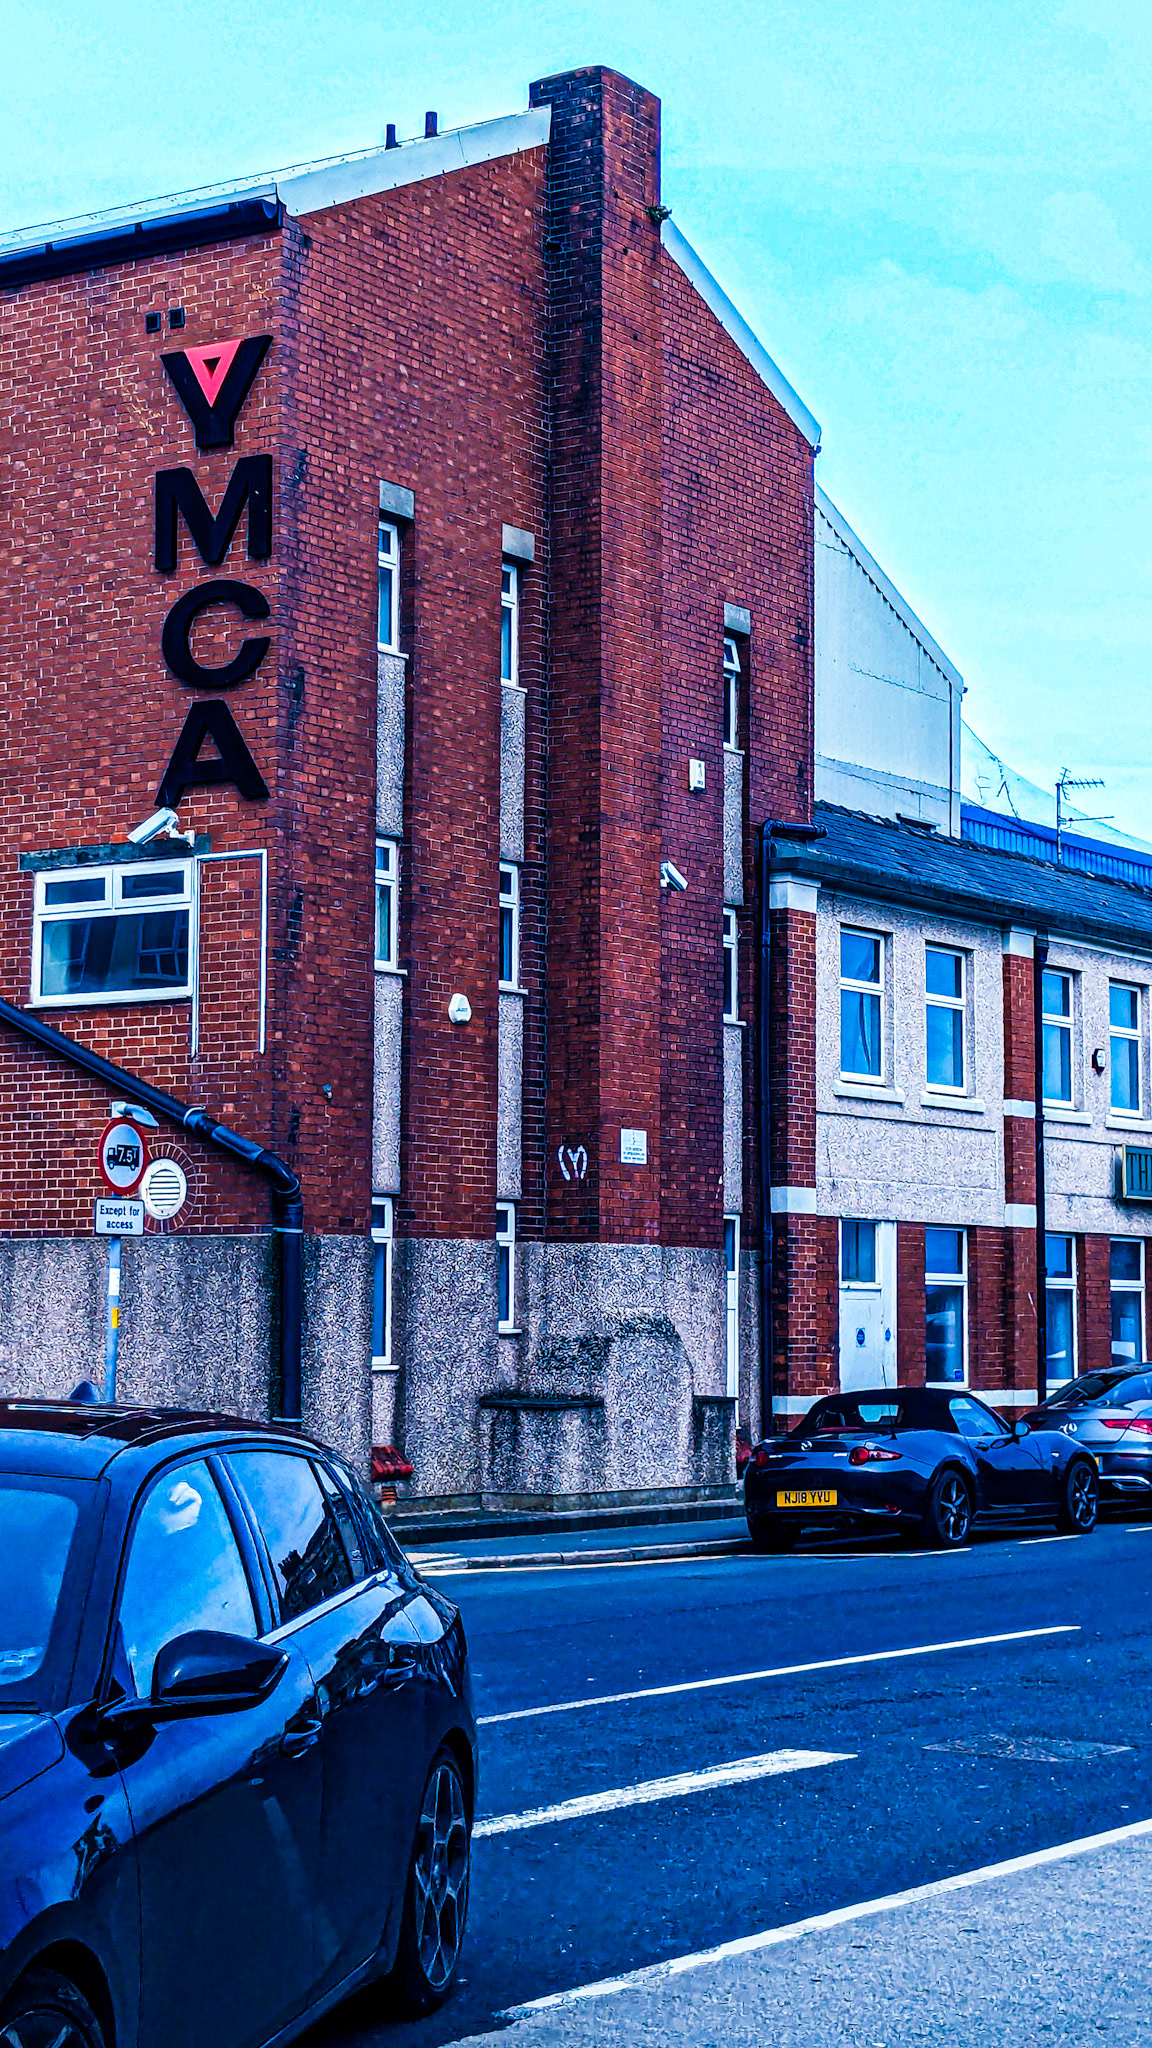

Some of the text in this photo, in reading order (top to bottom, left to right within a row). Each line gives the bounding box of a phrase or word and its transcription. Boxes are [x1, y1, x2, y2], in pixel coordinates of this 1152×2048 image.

[154, 334, 274, 808] YMCA
[1127, 1153, 1152, 1192] TH
[99, 1205, 140, 1217] Except for
[106, 1220, 134, 1230] access
[784, 1491, 831, 1504] NJ18 YVU
